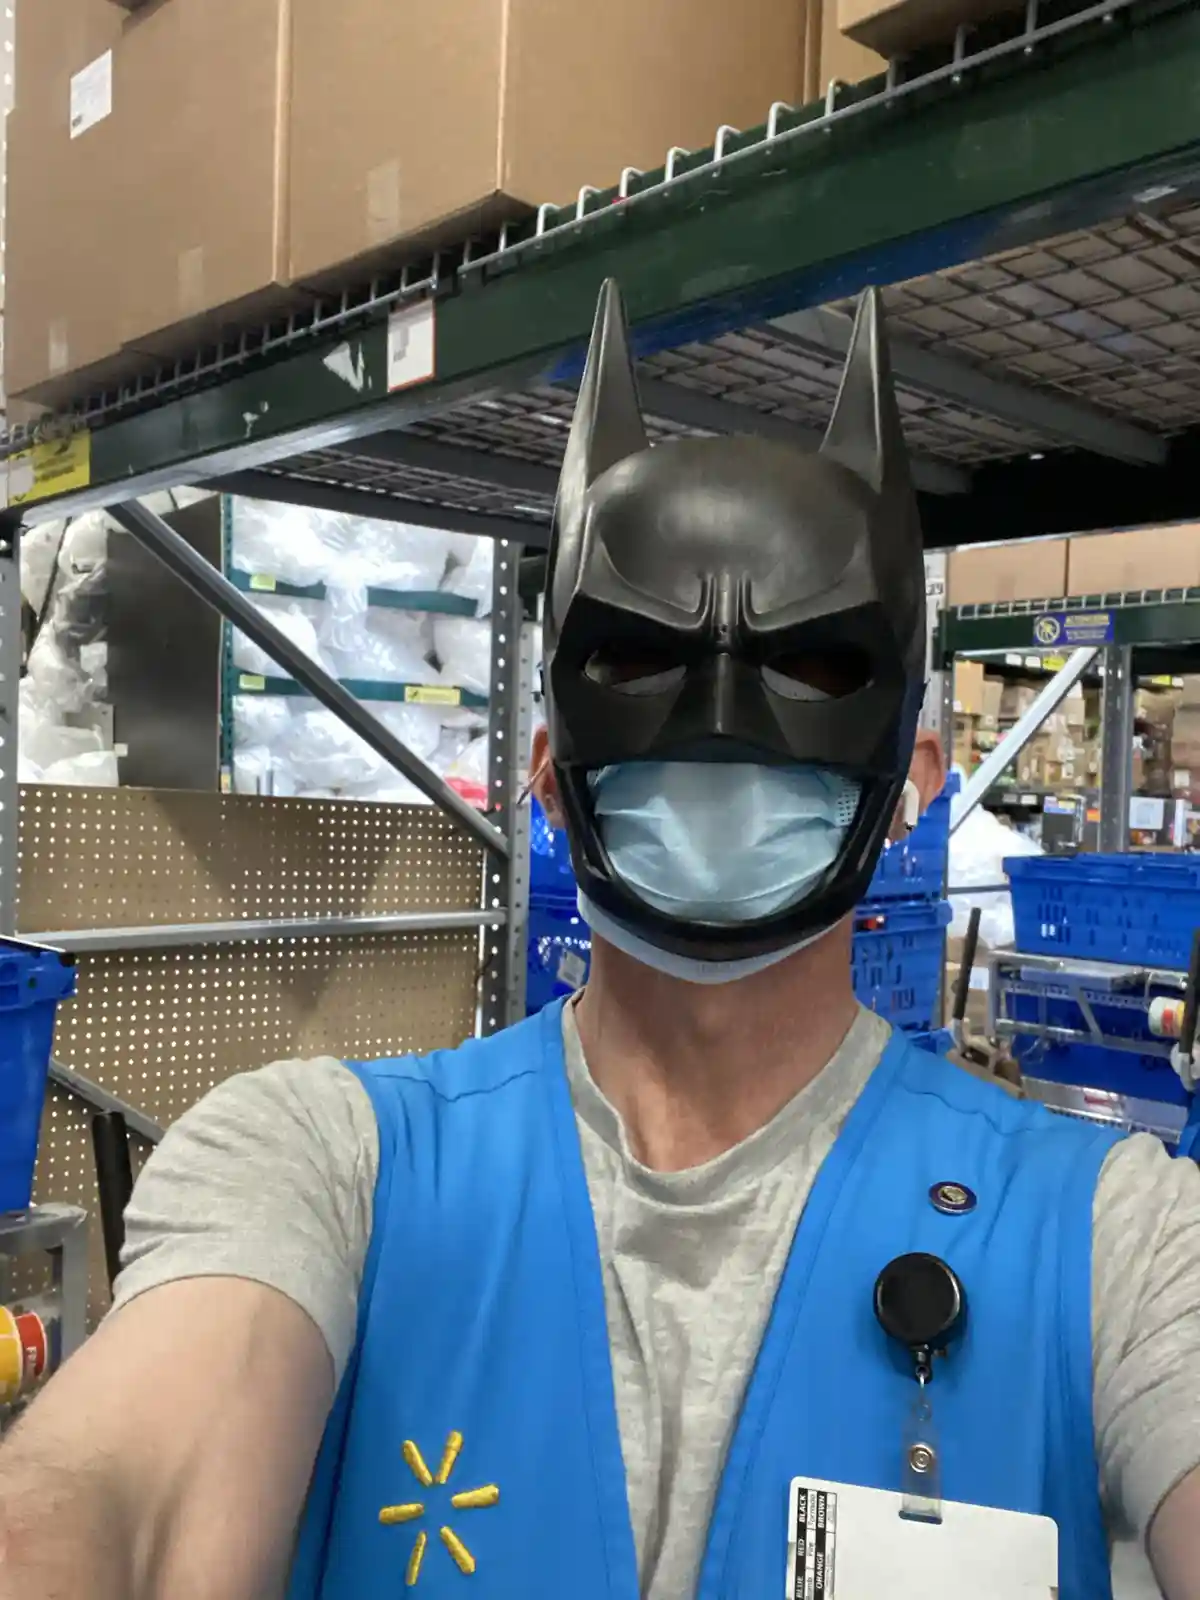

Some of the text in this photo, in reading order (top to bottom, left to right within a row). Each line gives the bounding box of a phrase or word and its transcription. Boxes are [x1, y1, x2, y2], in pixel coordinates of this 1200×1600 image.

[798, 1494, 806, 1523] BLACK
[817, 1495, 825, 1529] BROWN
[797, 1538, 805, 1557] RED
[815, 1551, 824, 1590] ORANGE
[796, 1575, 804, 1599] BLUE
